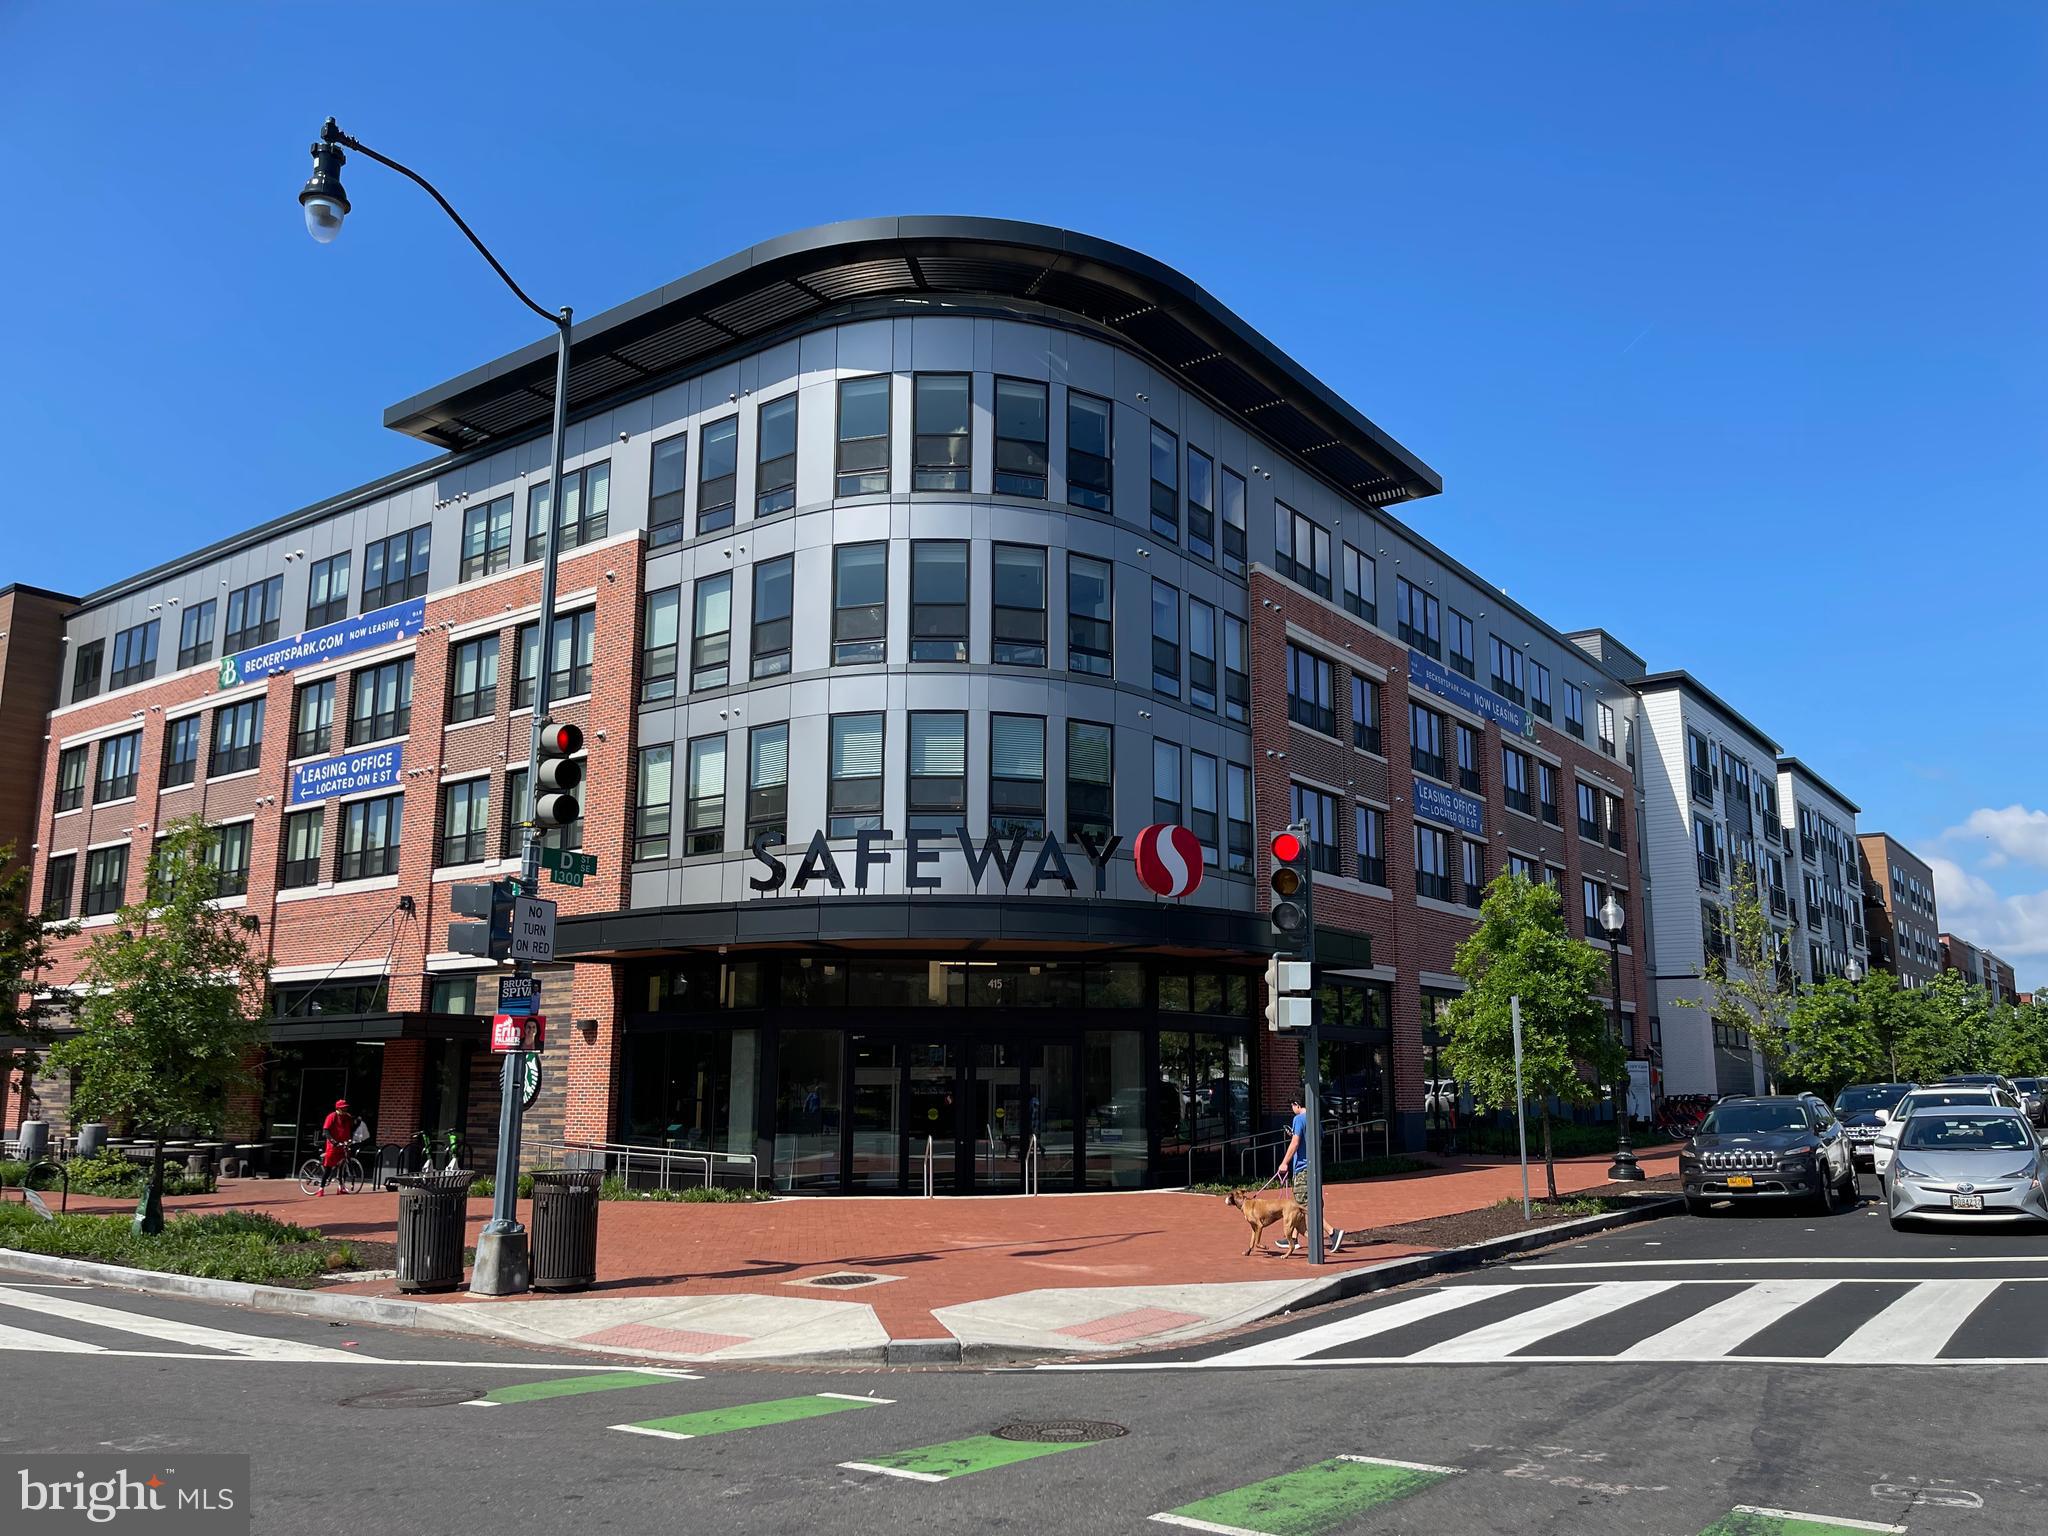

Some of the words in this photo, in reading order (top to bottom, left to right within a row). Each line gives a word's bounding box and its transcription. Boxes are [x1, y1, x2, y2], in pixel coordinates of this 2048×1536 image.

[244, 632, 344, 674] BECKERTSPARK.COM
[349, 627, 367, 641] NOW
[368, 618, 400, 635] LEASING
[1474, 692, 1491, 711] NOW
[1492, 702, 1519, 726] LEASING
[301, 761, 347, 784] LEASING
[351, 752, 393, 773] OFFICE
[316, 777, 355, 795] LOCATED
[356, 774, 370, 786] ON
[372, 772, 378, 783] E
[380, 769, 392, 782] ST
[1419, 784, 1451, 808] LEASING
[1453, 797, 1477, 817] OFFICE
[1430, 804, 1457, 821] LOCATED
[1457, 814, 1466, 825] ON
[1466, 817, 1470, 827] E
[1471, 818, 1477, 829] ST
[560, 852, 573, 870] D
[580, 855, 592, 865] ST
[580, 863, 591, 873] SE
[749, 826, 1124, 892] SAFEWAY
[554, 870, 581, 886] 1300
[528, 905, 543, 919] NO
[523, 922, 547, 937] TURN
[515, 939, 529, 952] ON
[532, 941, 550, 955] RED
[502, 978, 532, 989] BRUCE
[987, 978, 1003, 989] 415
